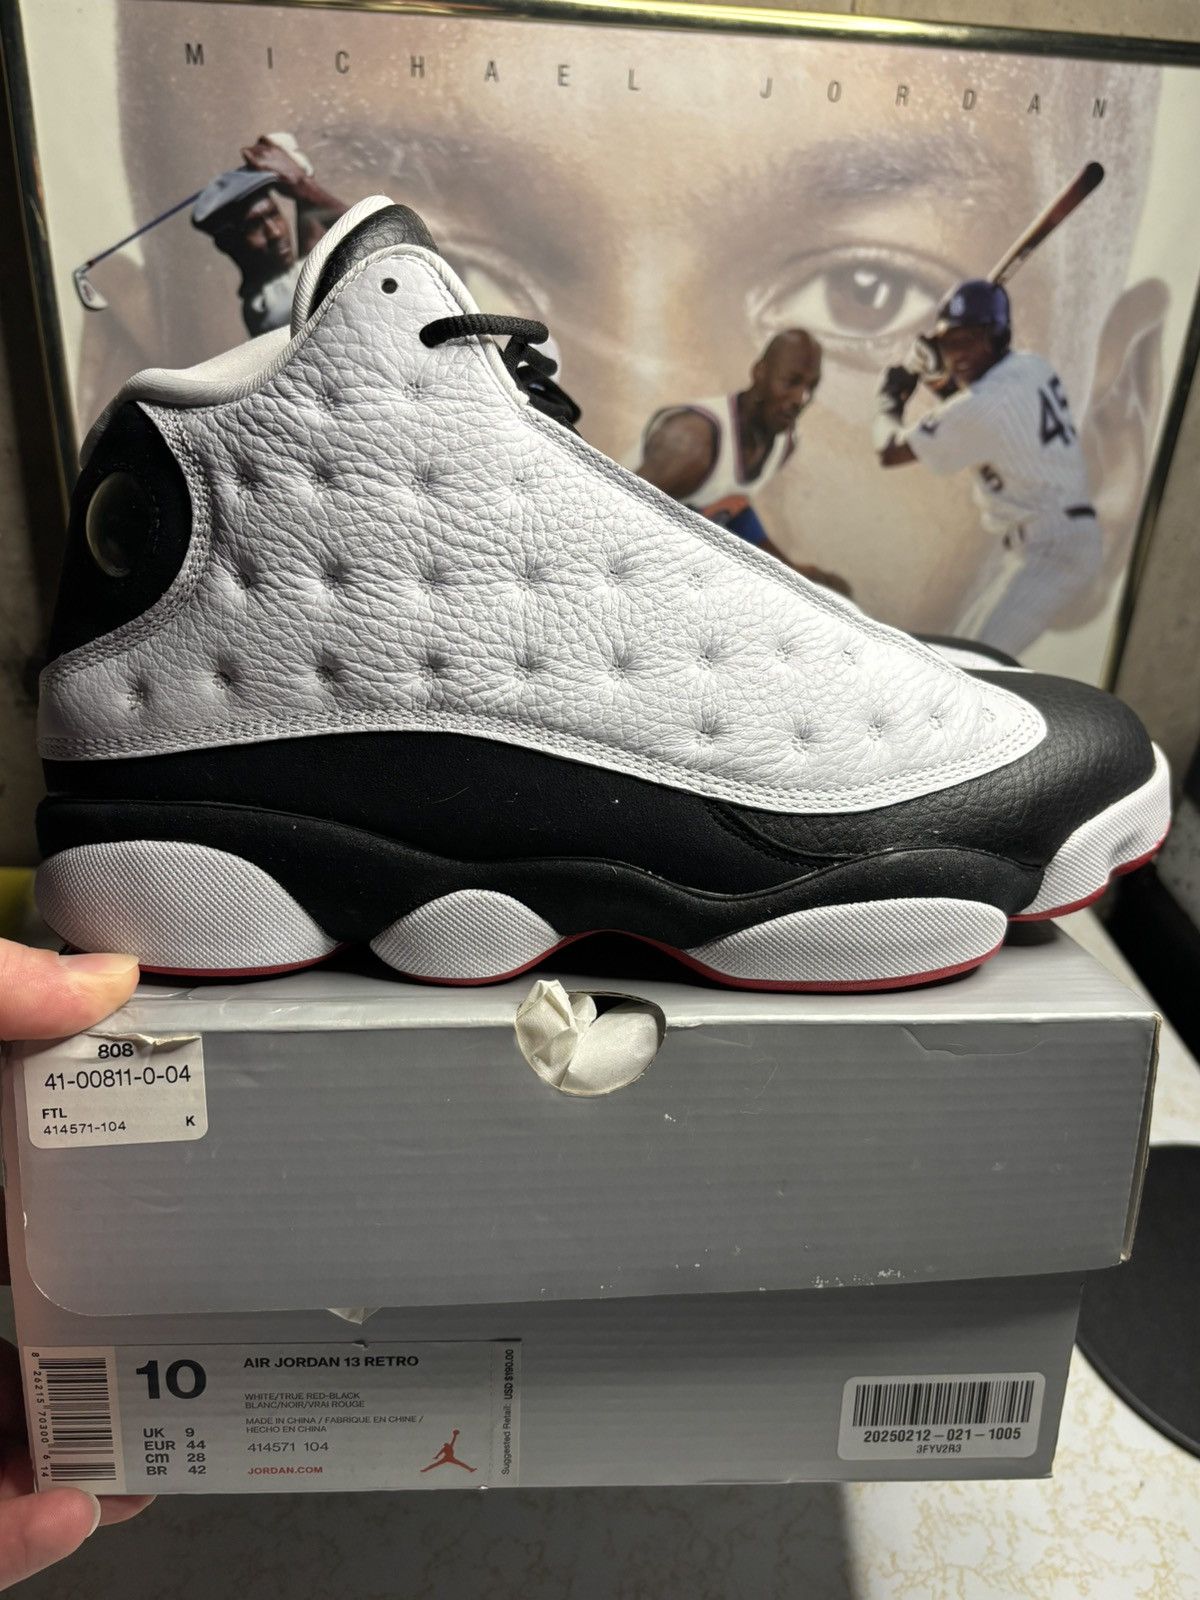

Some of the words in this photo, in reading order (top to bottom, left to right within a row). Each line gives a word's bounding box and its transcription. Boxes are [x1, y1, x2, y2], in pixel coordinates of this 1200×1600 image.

[184, 42, 641, 92] MICHAEL
[758, 76, 1108, 119] JORDAN
[98, 1042, 134, 1059] 808
[44, 1065, 192, 1090] 41-00811-0-04
[42, 1107, 68, 1119] FTL
[186, 1115, 196, 1127] K
[43, 1121, 127, 1136] 414571-104
[244, 1357, 270, 1368] AIR
[274, 1357, 340, 1368] JORDAN
[344, 1356, 361, 1367] 13
[364, 1356, 419, 1367] RETRO
[504, 1349, 514, 1382] $190.00
[136, 1359, 207, 1400] 10
[33, 1370, 45, 1404] 26215
[504, 1383, 514, 1400] USD
[244, 1392, 304, 1401] WHITE/TRUE
[306, 1391, 361, 1400] RED-BLACK
[245, 1400, 330, 1409] BLANC/NOIR/VRAI
[332, 1400, 366, 1408] ROUGE
[245, 1417, 273, 1425] MADE
[275, 1417, 285, 1425] IN
[287, 1417, 316, 1425] CHINA
[324, 1416, 371, 1425] FABRIQUE
[373, 1416, 387, 1424] EN
[388, 1415, 417, 1423] CHINE
[37, 1411, 49, 1444] 70300
[143, 1428, 165, 1438] UK
[185, 1428, 195, 1438] 9
[246, 1426, 280, 1434] HECHO
[297, 1425, 327, 1433] CHINA
[144, 1441, 176, 1451] EUR
[186, 1440, 206, 1450] 44
[247, 1442, 295, 1452] 414571
[305, 1441, 329, 1451] 104
[916, 1444, 962, 1454] 3FYV2R3
[187, 1453, 206, 1463] 28
[501, 1431, 512, 1476] Suggested
[146, 1466, 168, 1476] BR
[188, 1465, 207, 1475] 42
[247, 1466, 323, 1476] JORDAN.COM
